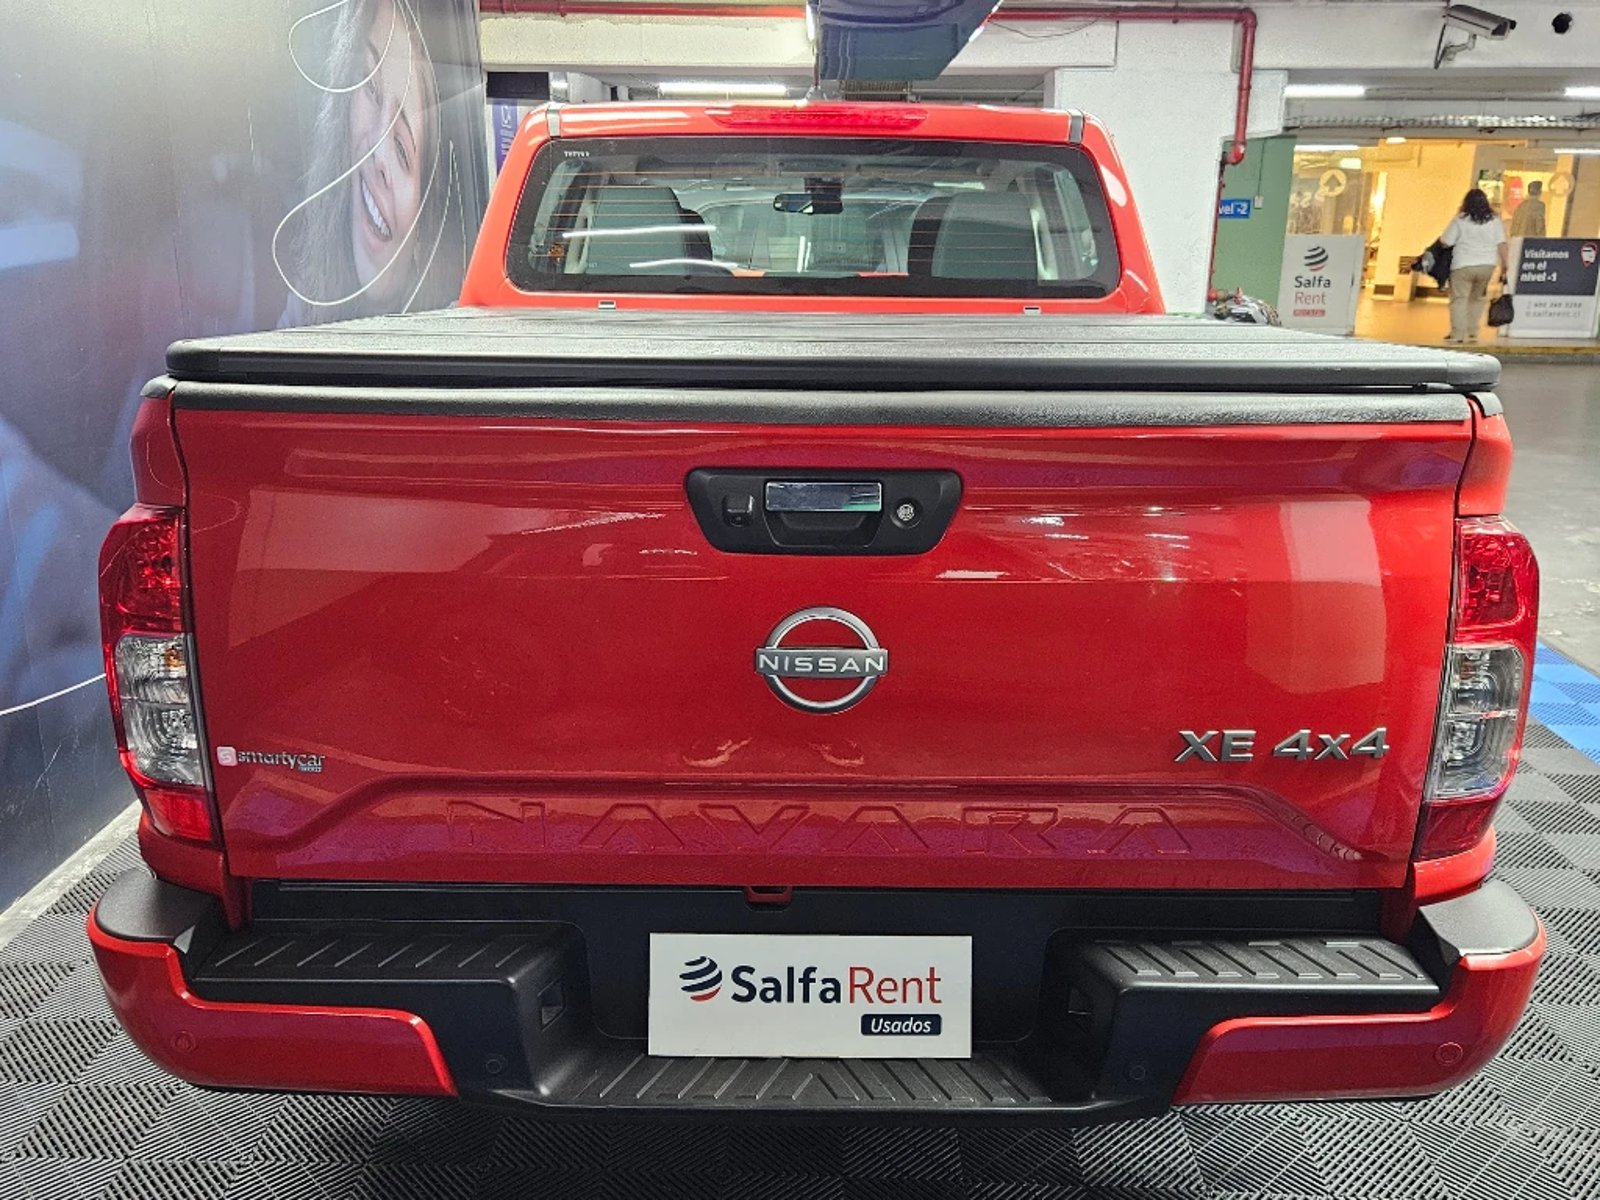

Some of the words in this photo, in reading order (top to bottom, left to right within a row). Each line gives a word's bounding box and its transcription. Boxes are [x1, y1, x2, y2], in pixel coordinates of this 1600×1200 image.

[1218, 202, 1234, 215] vel
[1522, 261, 1535, 271] en
[1537, 260, 1547, 271] el
[1294, 275, 1332, 288] Salfa
[1519, 271, 1547, 282] nivel
[1294, 291, 1328, 305] Rent
[758, 653, 884, 673] NISSAN
[1174, 728, 1257, 763] XE
[1272, 726, 1390, 762] 4x4
[237, 751, 326, 769] smartycar
[446, 799, 1193, 854] NAVARA
[730, 964, 943, 1004] SalfaRent
[869, 1016, 933, 1035] Usados
